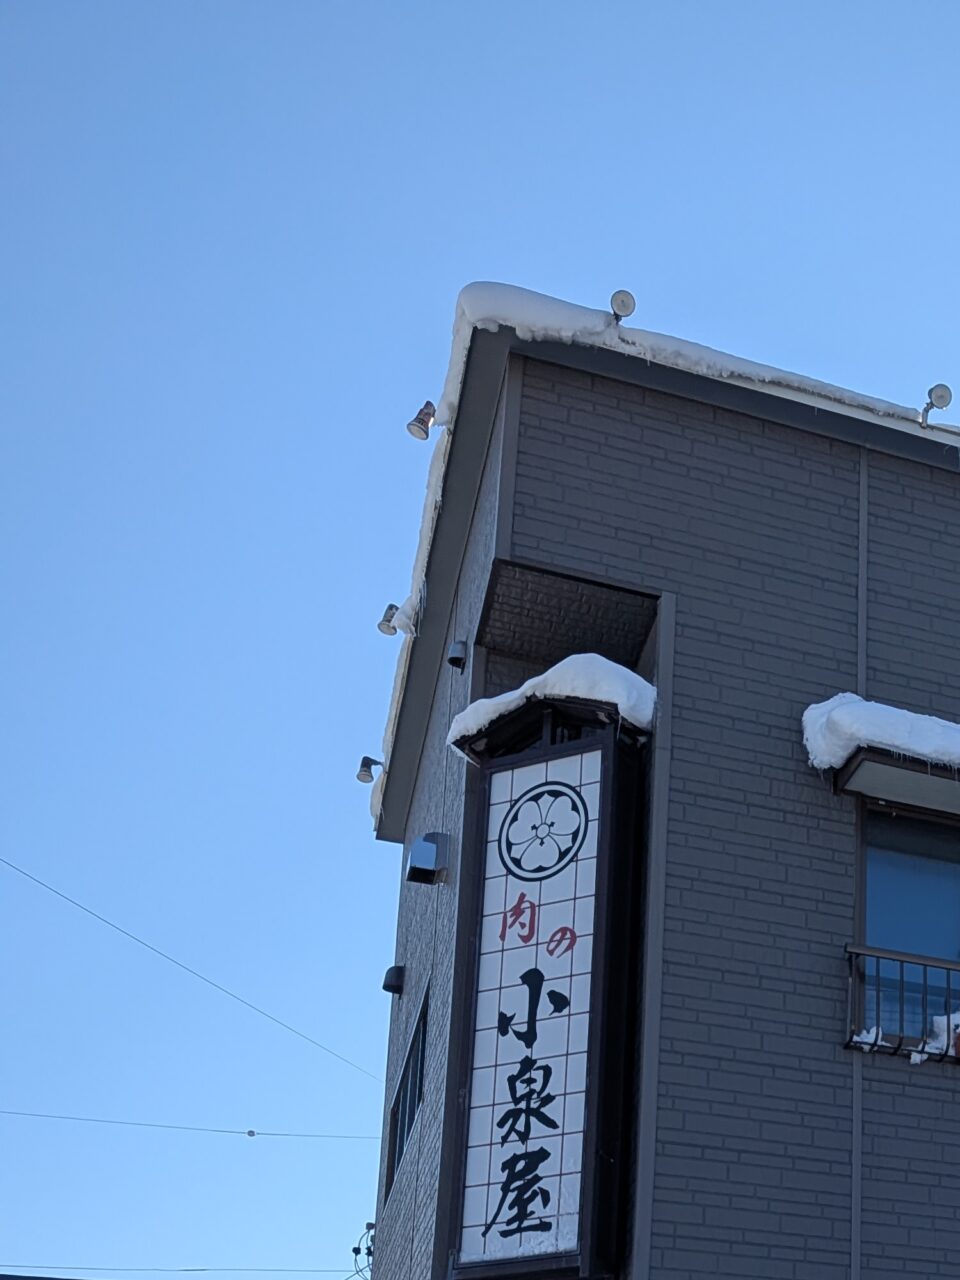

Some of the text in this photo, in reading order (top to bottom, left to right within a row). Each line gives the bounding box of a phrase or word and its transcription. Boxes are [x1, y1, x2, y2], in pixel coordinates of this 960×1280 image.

[499, 892, 577, 958] 肉の
[482, 968, 570, 1238] 小泉屋
